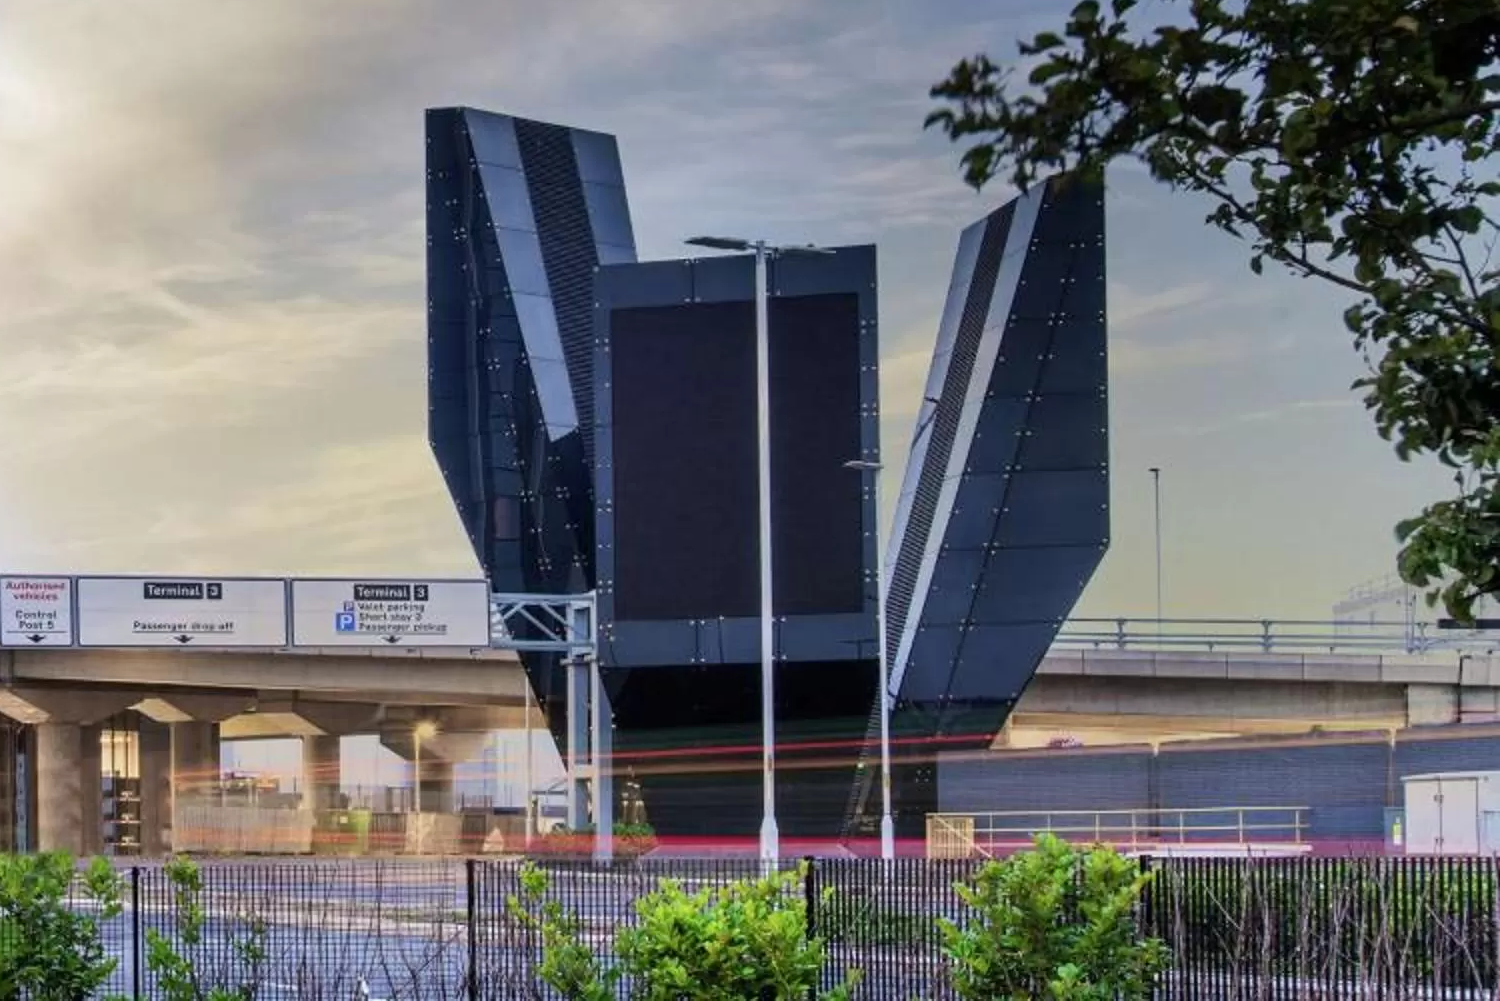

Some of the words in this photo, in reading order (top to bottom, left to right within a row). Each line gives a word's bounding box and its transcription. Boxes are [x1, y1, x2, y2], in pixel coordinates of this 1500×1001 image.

[5, 581, 65, 590] Authorised
[147, 584, 201, 596] Terminal
[11, 591, 58, 600] vehicles
[357, 586, 408, 598] Terminal
[417, 587, 425, 598] 3
[387, 601, 425, 613] parking
[15, 610, 57, 619] Control
[359, 611, 387, 620] Short
[390, 612, 413, 622] stay
[19, 620, 43, 629] Post
[133, 620, 187, 631] Passenger
[218, 621, 233, 630] off
[359, 621, 409, 632] Passenger
